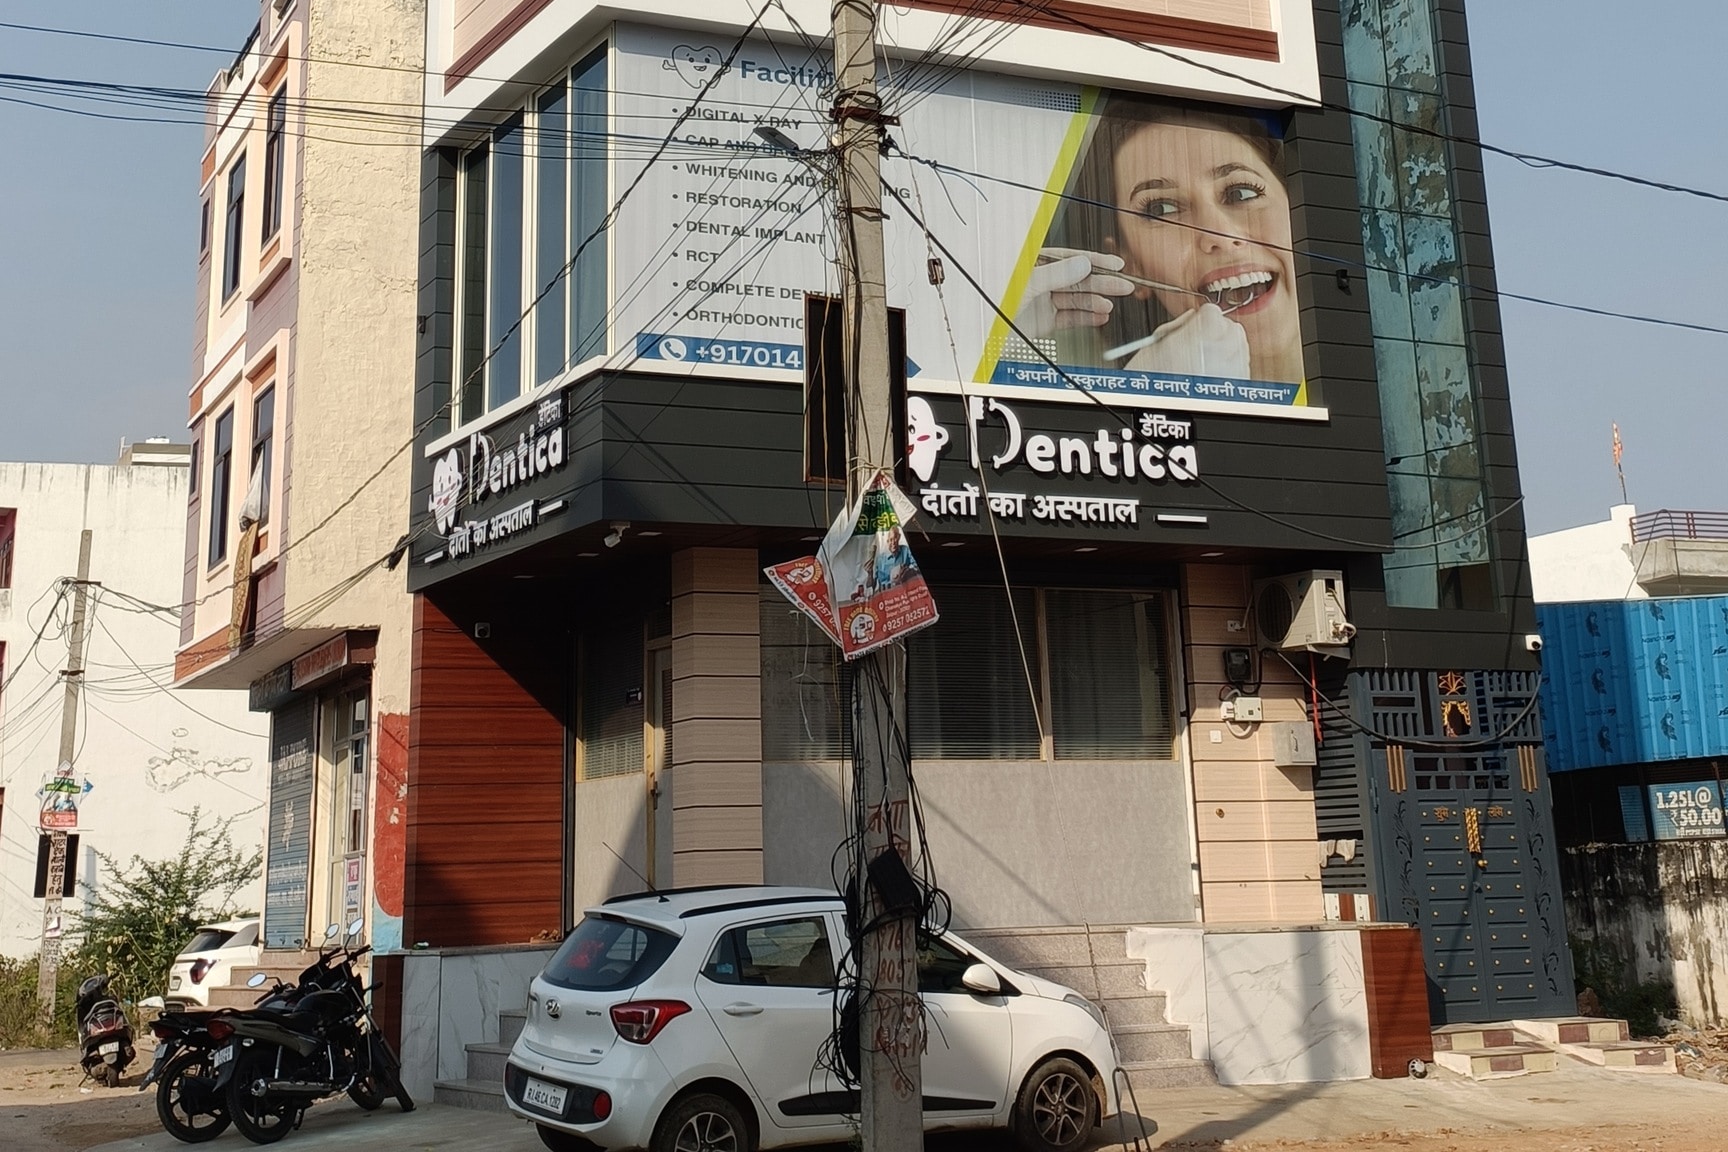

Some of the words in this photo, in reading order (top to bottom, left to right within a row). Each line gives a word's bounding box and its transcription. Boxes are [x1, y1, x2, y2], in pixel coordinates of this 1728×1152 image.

[686, 106, 750, 124] DIGITAL
[770, 116, 801, 130] RAY
[686, 134, 719, 148] CAP
[686, 163, 778, 183] WHITENING
[783, 174, 816, 188] AND
[686, 191, 802, 214] RESTORATION
[686, 221, 750, 238] DENTAL
[755, 227, 826, 244] IMPLANT
[686, 250, 720, 264] RCT
[686, 279, 775, 298] COMPLETE
[696, 344, 801, 369] +917014
[1130, 374, 1150, 390] को
[1195, 381, 1235, 397] अपनी
[1139, 412, 1192, 440] डेंटिका
[970, 396, 1199, 481] Dentica
[469, 424, 563, 504] Dentica
[986, 491, 1026, 517] का
[1031, 495, 1140, 523] अस्पताल
[473, 519, 488, 546] का
[489, 499, 534, 540] अस्पताल
[886, 616, 905, 631] 9257
